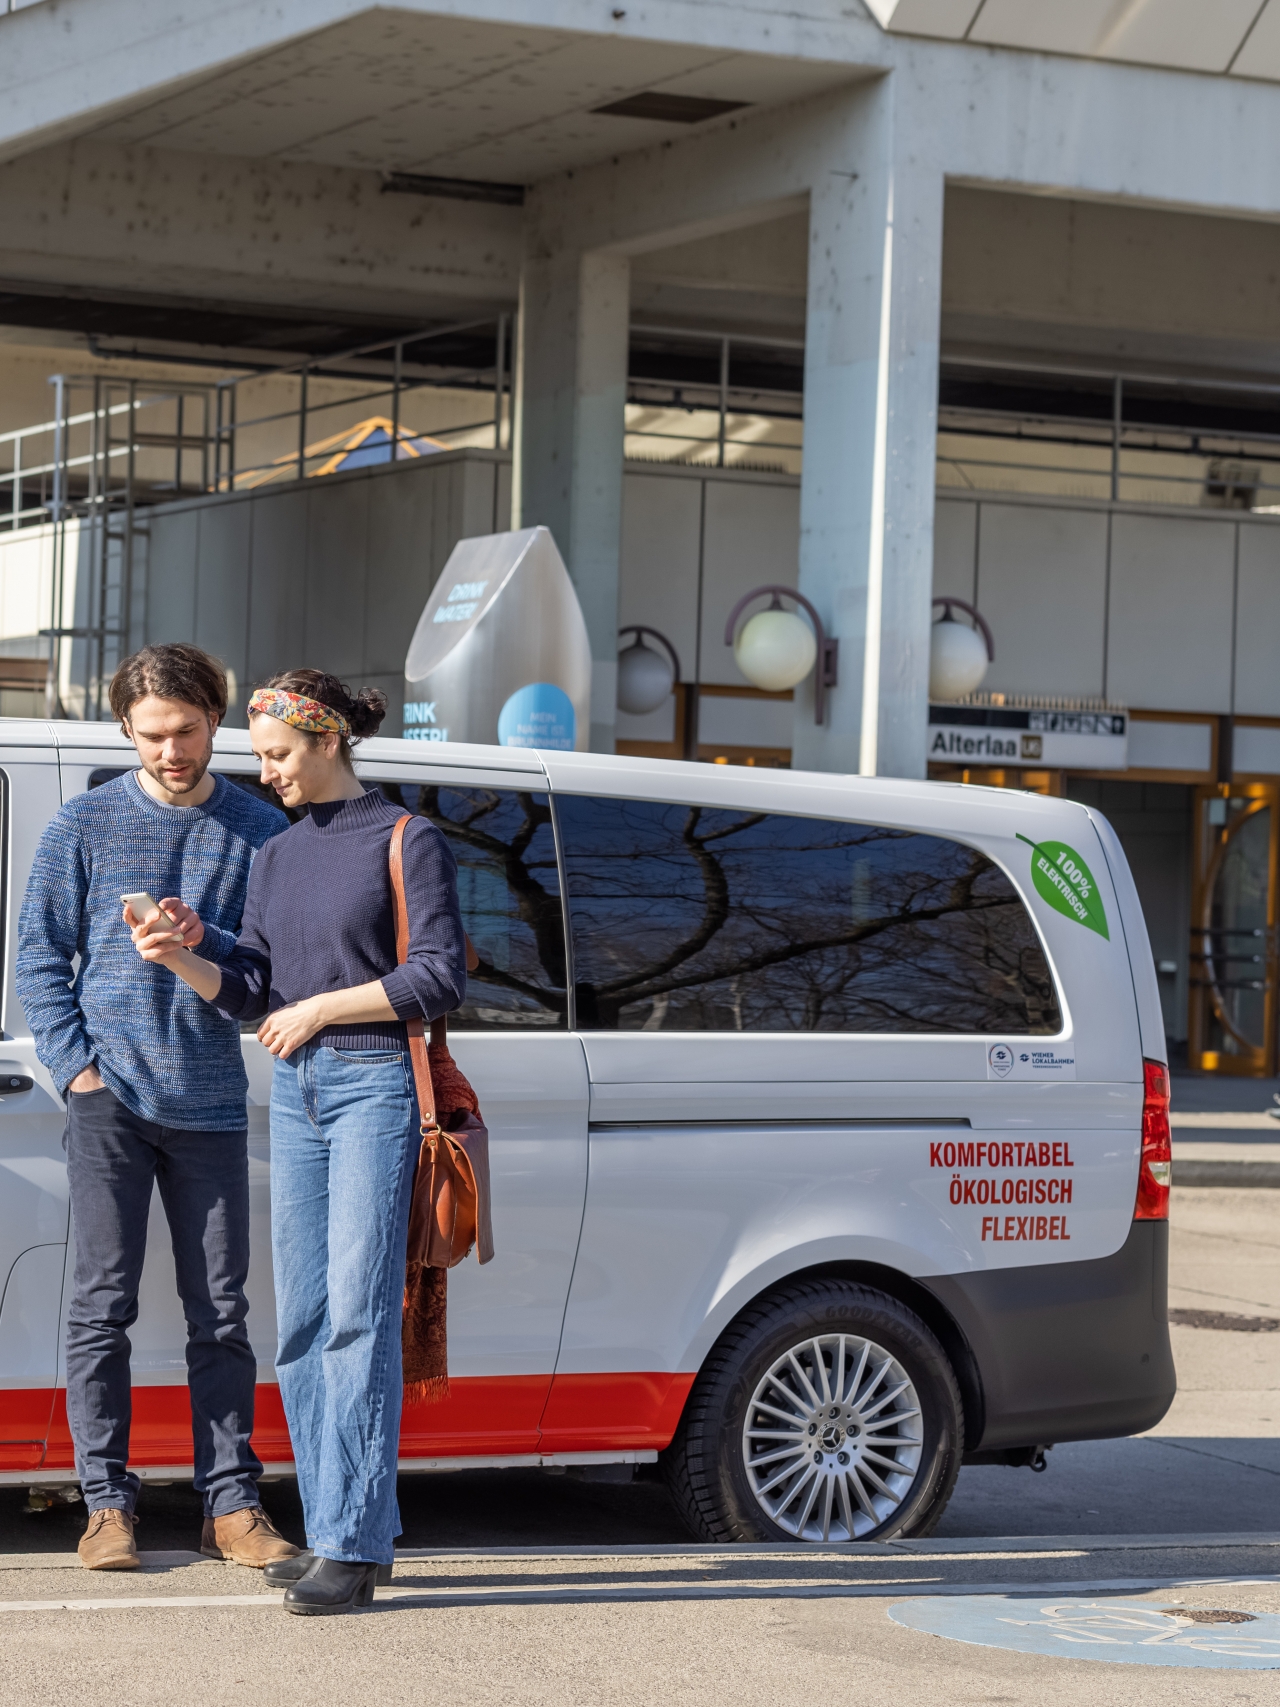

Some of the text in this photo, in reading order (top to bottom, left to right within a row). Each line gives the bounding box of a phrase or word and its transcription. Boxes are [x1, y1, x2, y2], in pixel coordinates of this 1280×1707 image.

[447, 580, 489, 602] DRINK
[403, 701, 437, 724] RINK
[530, 712, 557, 723] MEIN
[517, 724, 548, 736] NAME
[931, 731, 1017, 757] Alterlaa
[1056, 851, 1092, 899] 100%
[1037, 857, 1088, 920] ELEKTRISCH
[929, 1142, 1074, 1167] KOMFORTABEL
[949, 1174, 1073, 1205] ÖKOLOGISCH
[981, 1216, 1071, 1242] FLEXIBEL
